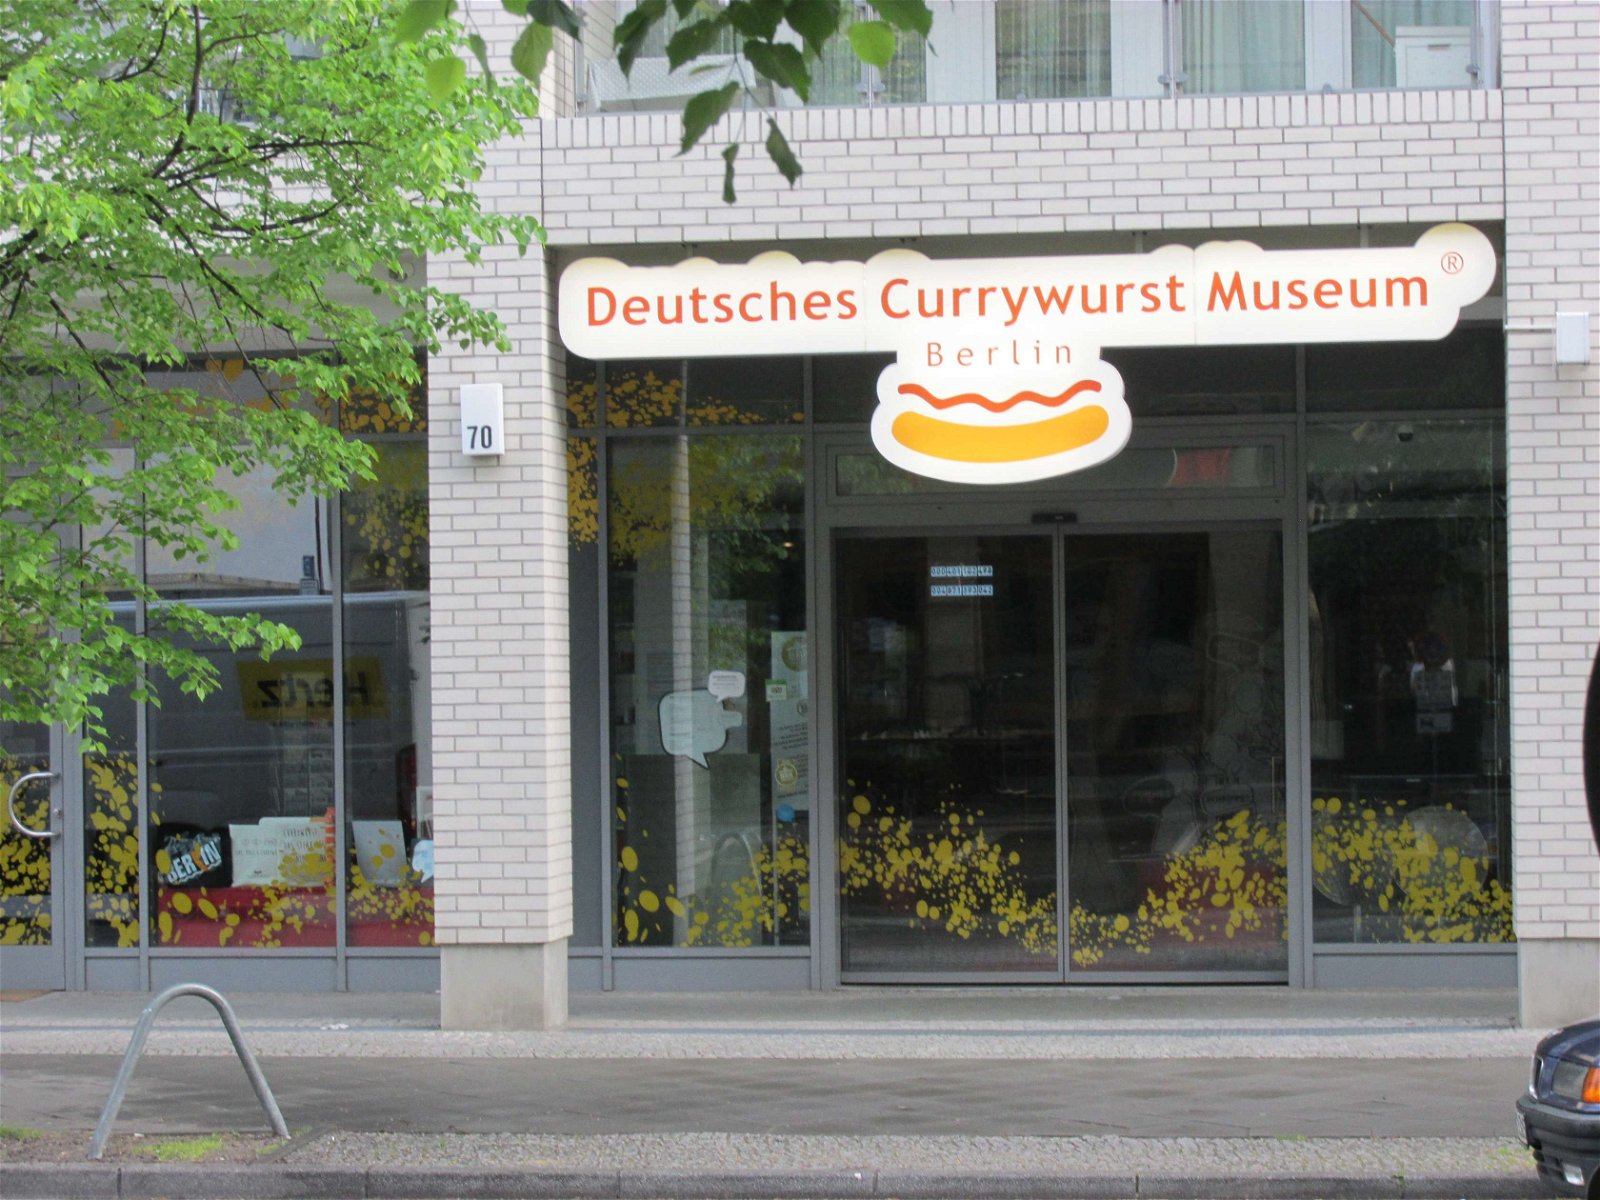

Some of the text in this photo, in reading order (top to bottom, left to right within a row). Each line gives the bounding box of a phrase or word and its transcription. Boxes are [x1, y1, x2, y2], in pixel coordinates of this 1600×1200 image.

[587, 280, 858, 327] Deutsches
[880, 274, 1186, 327] Currywurst
[1207, 271, 1428, 312] Museum
[926, 339, 1073, 368] Berlin
[467, 425, 492, 449] 70
